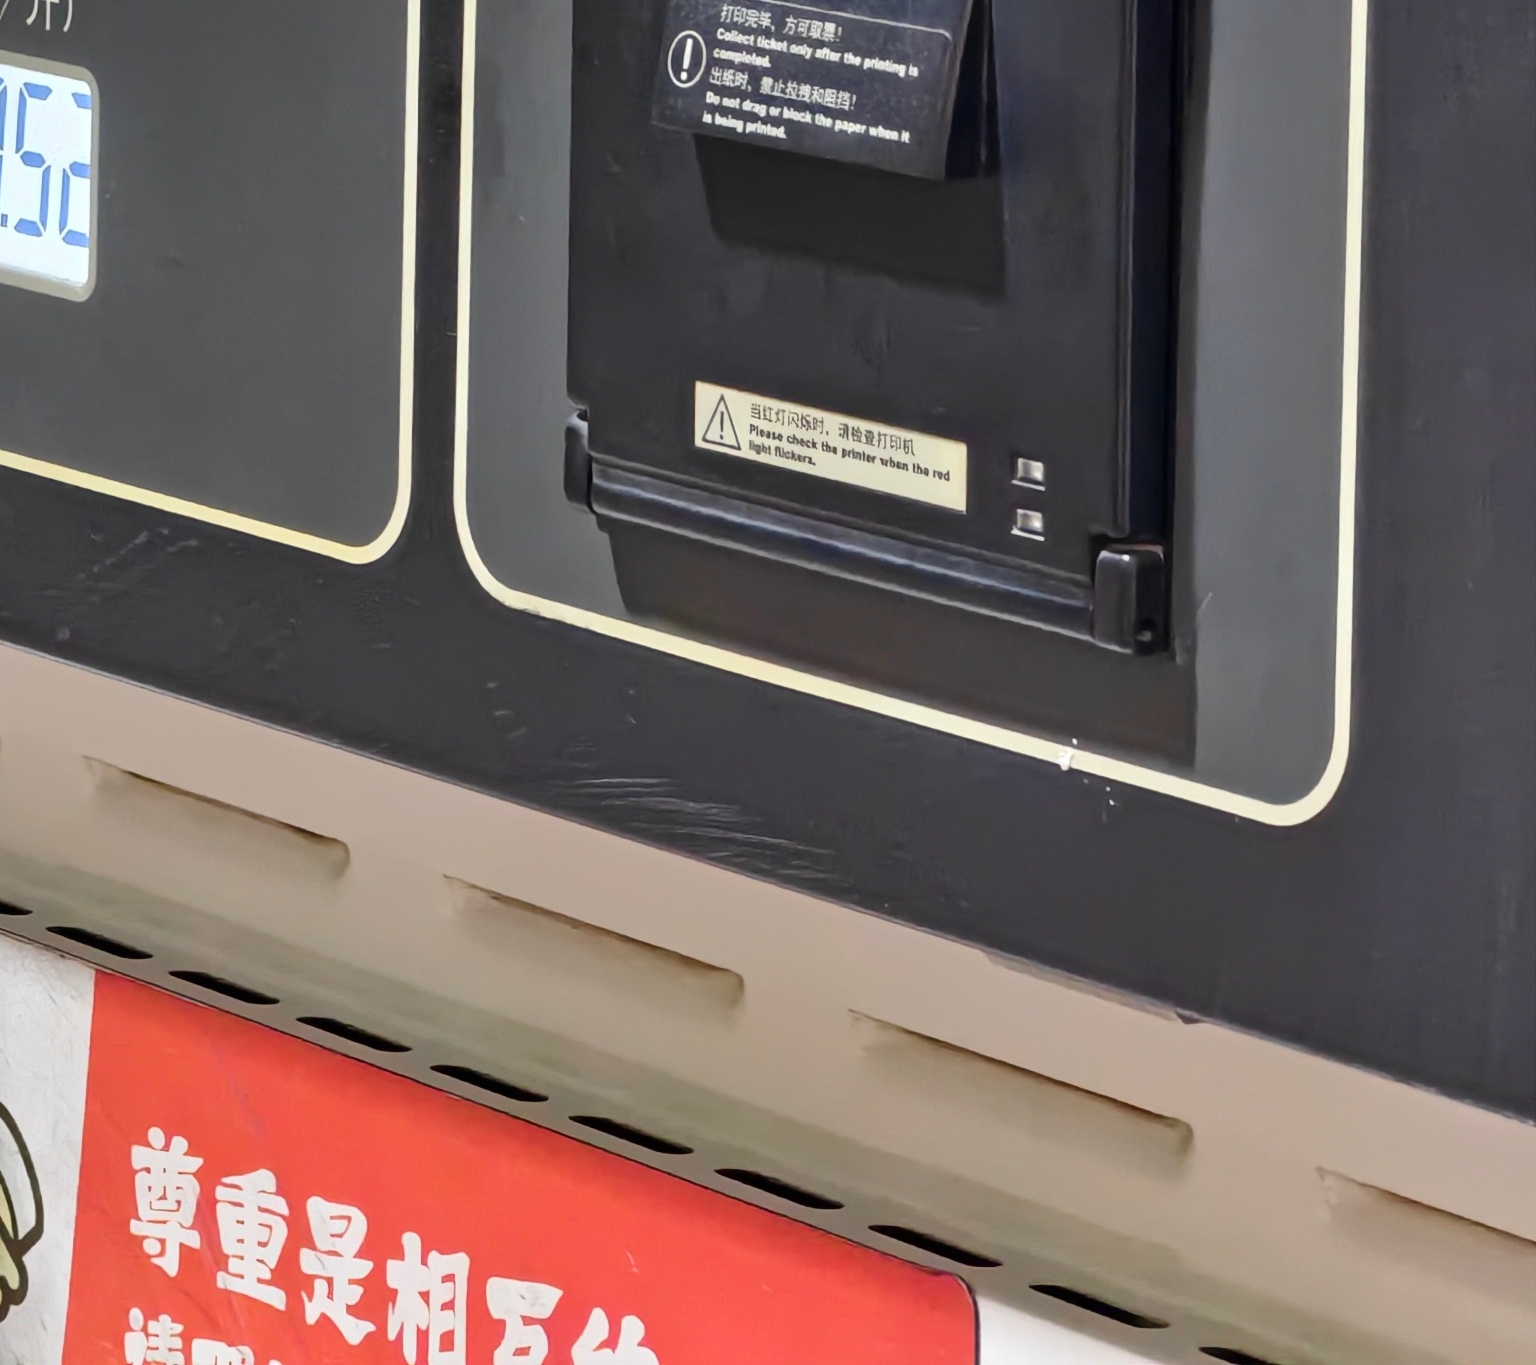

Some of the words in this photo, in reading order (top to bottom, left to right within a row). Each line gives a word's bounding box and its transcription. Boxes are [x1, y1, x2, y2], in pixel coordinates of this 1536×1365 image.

[712, 47, 772, 68] completed.
[716, 27, 755, 47] Collect
[756, 36, 788, 53] ticket
[789, 43, 813, 60] only
[814, 46, 842, 63] after
[843, 52, 862, 67] the
[863, 57, 907, 79] printing
[705, 91, 721, 106] Do
[721, 96, 741, 110] not
[741, 99, 767, 118] drag
[768, 105, 782, 118] or
[782, 106, 813, 125] block
[814, 113, 834, 129] the
[834, 119, 867, 136] paper
[868, 125, 900, 142] when
[900, 129, 911, 144] it
[714, 112, 744, 134] being
[745, 120, 788, 140] printed.
[748, 438, 773, 456] light
[774, 445, 817, 467] flickers.
[749, 423, 784, 443] Please
[786, 433, 819, 451] check
[821, 440, 839, 456] the
[841, 447, 877, 465] printer
[879, 456, 910, 473] when
[912, 462, 930, 478] the
[932, 470, 951, 483] red
